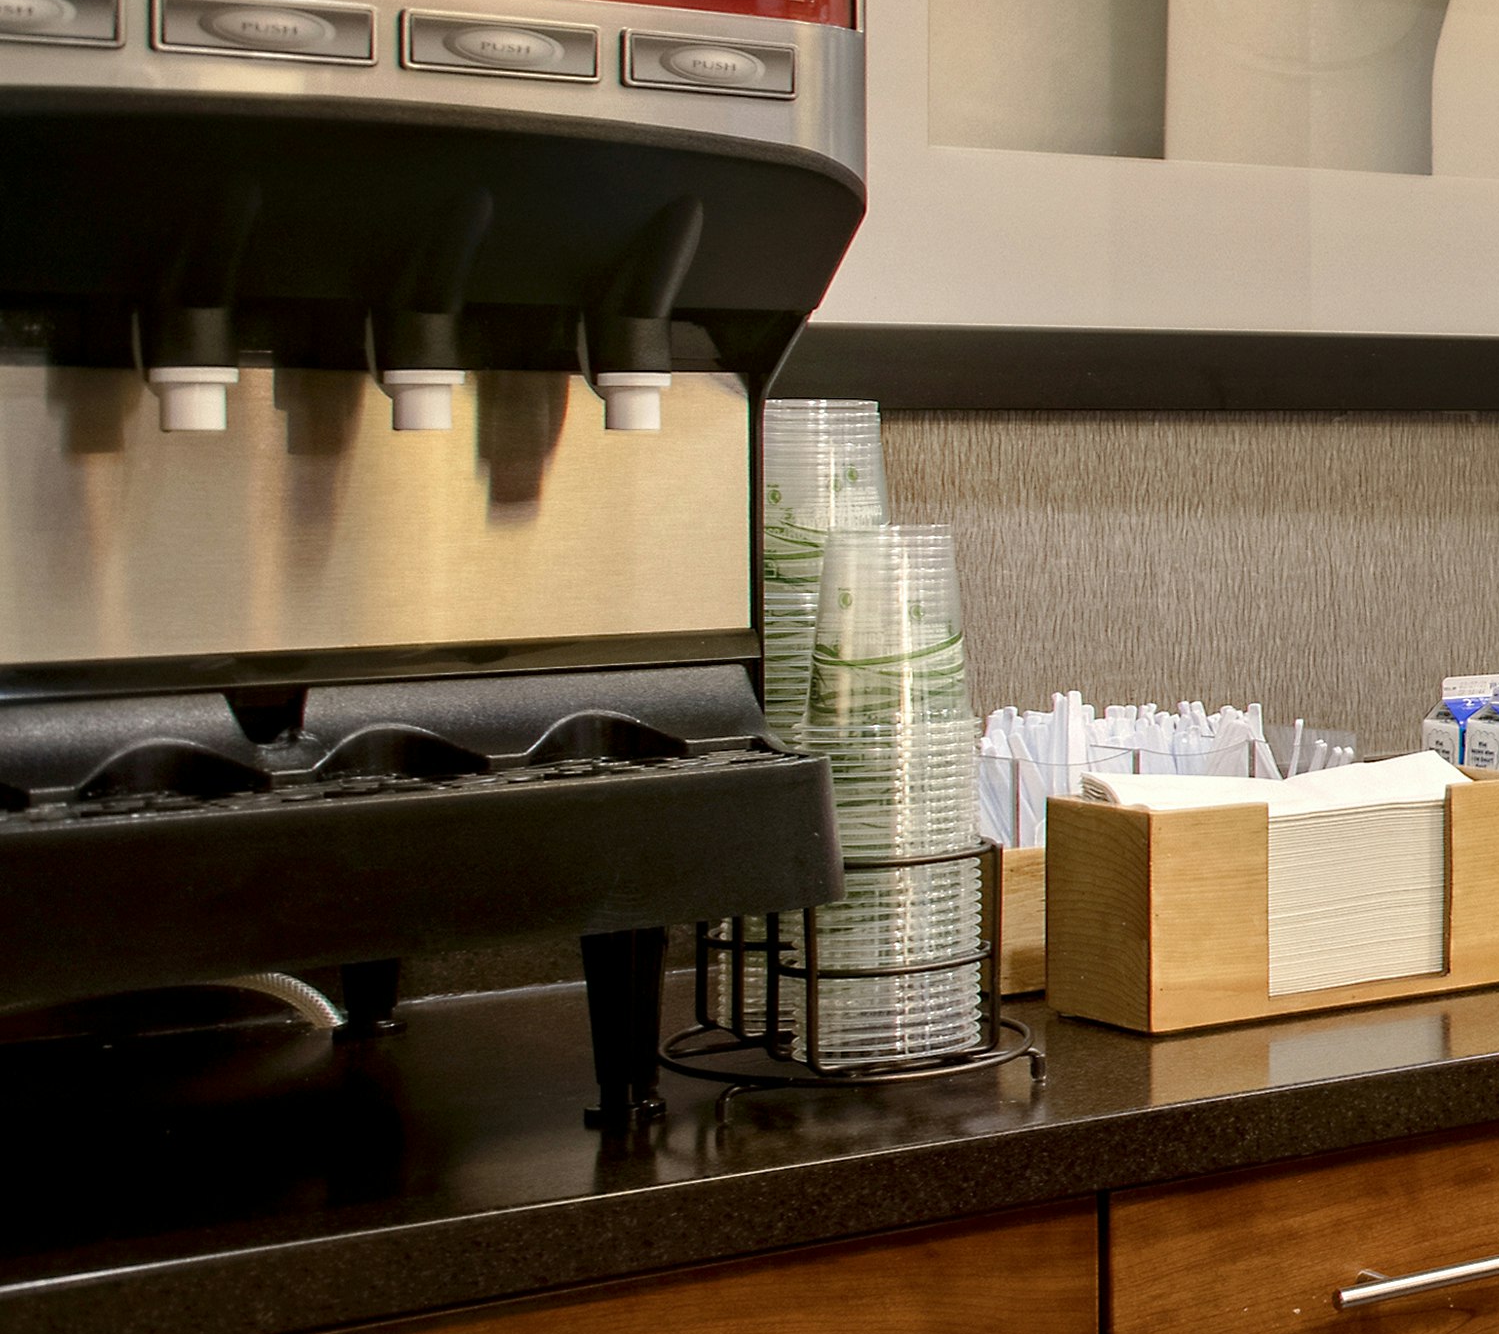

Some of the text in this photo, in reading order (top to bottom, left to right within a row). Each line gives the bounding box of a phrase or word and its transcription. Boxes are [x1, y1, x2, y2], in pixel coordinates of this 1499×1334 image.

[240, 20, 299, 36] PUSH
[480, 40, 532, 55] PUSH
[692, 58, 737, 72] PUSH
